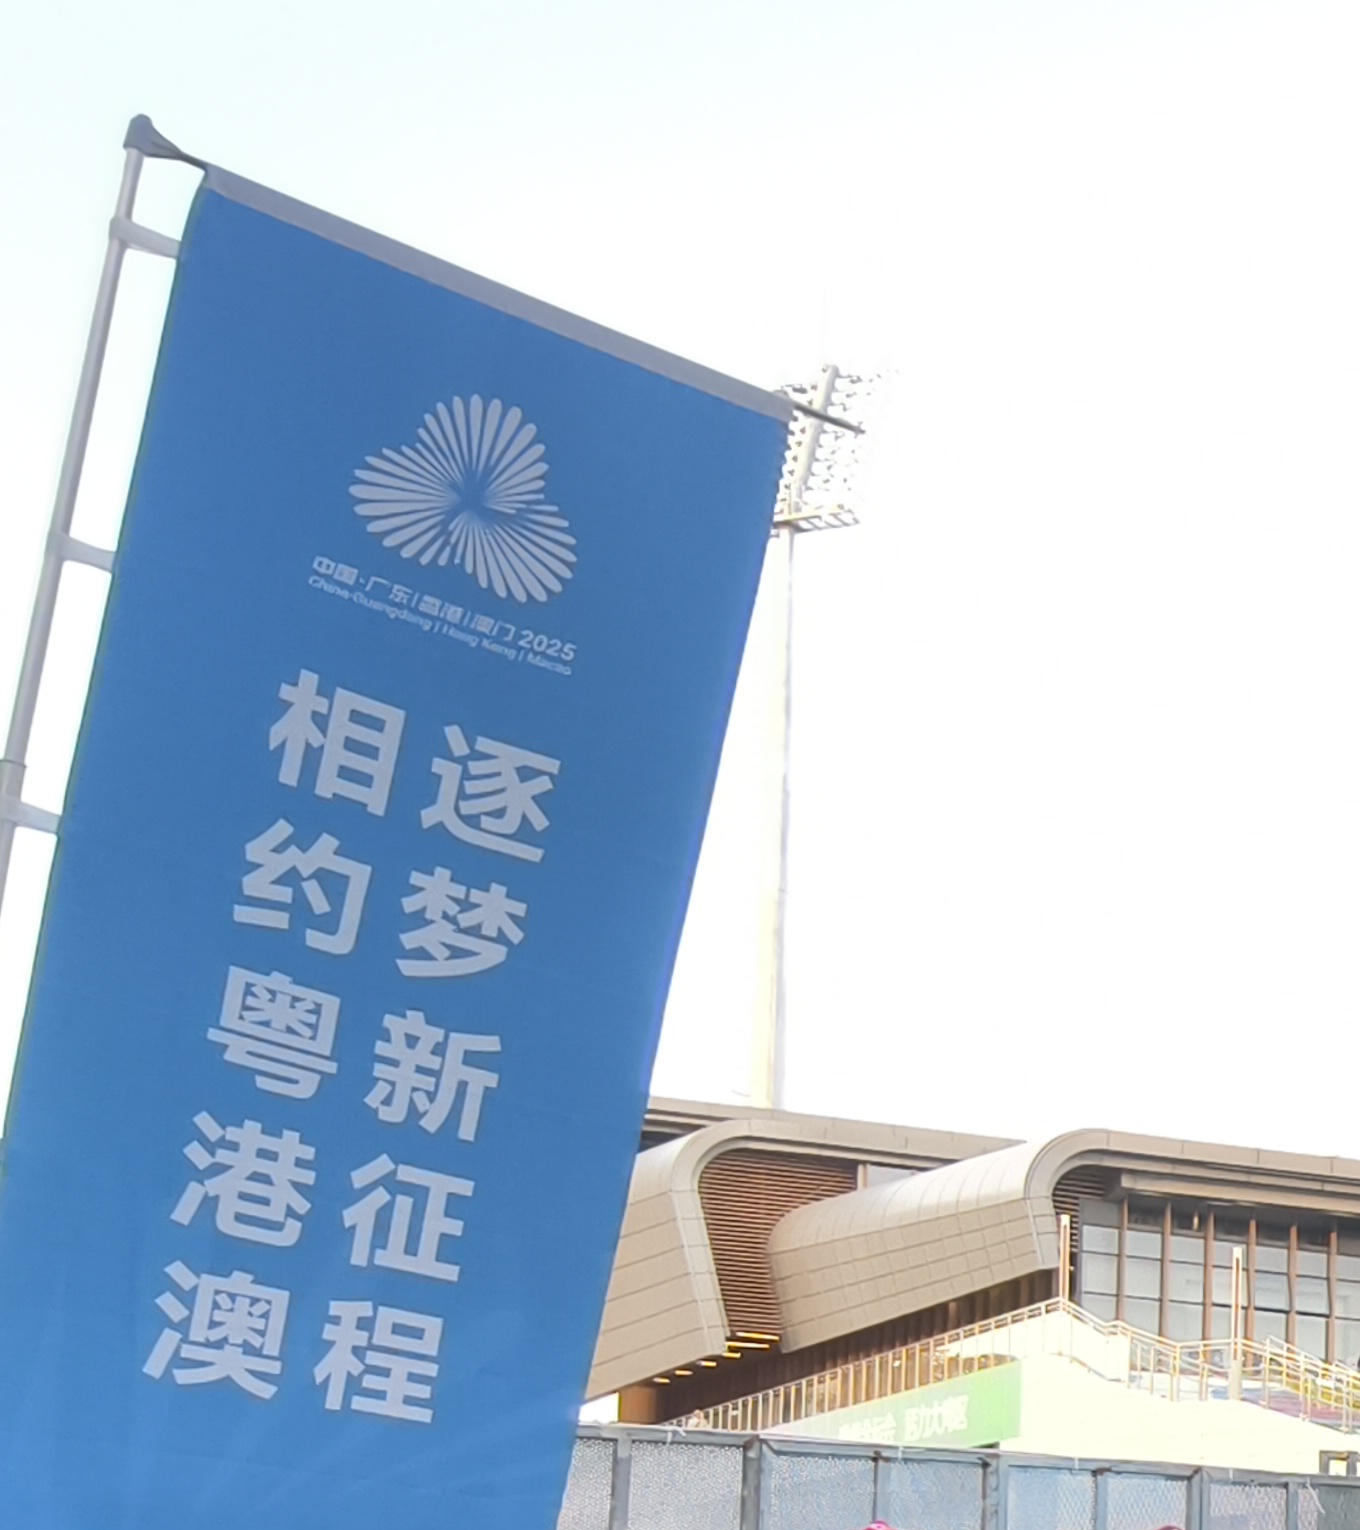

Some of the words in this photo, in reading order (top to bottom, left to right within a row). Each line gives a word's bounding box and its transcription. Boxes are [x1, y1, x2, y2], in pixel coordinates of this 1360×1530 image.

[517, 629, 578, 661] 2025
[142, 668, 406, 1400] 相约粤港澳
[312, 724, 562, 1424] 逐梦新征程
